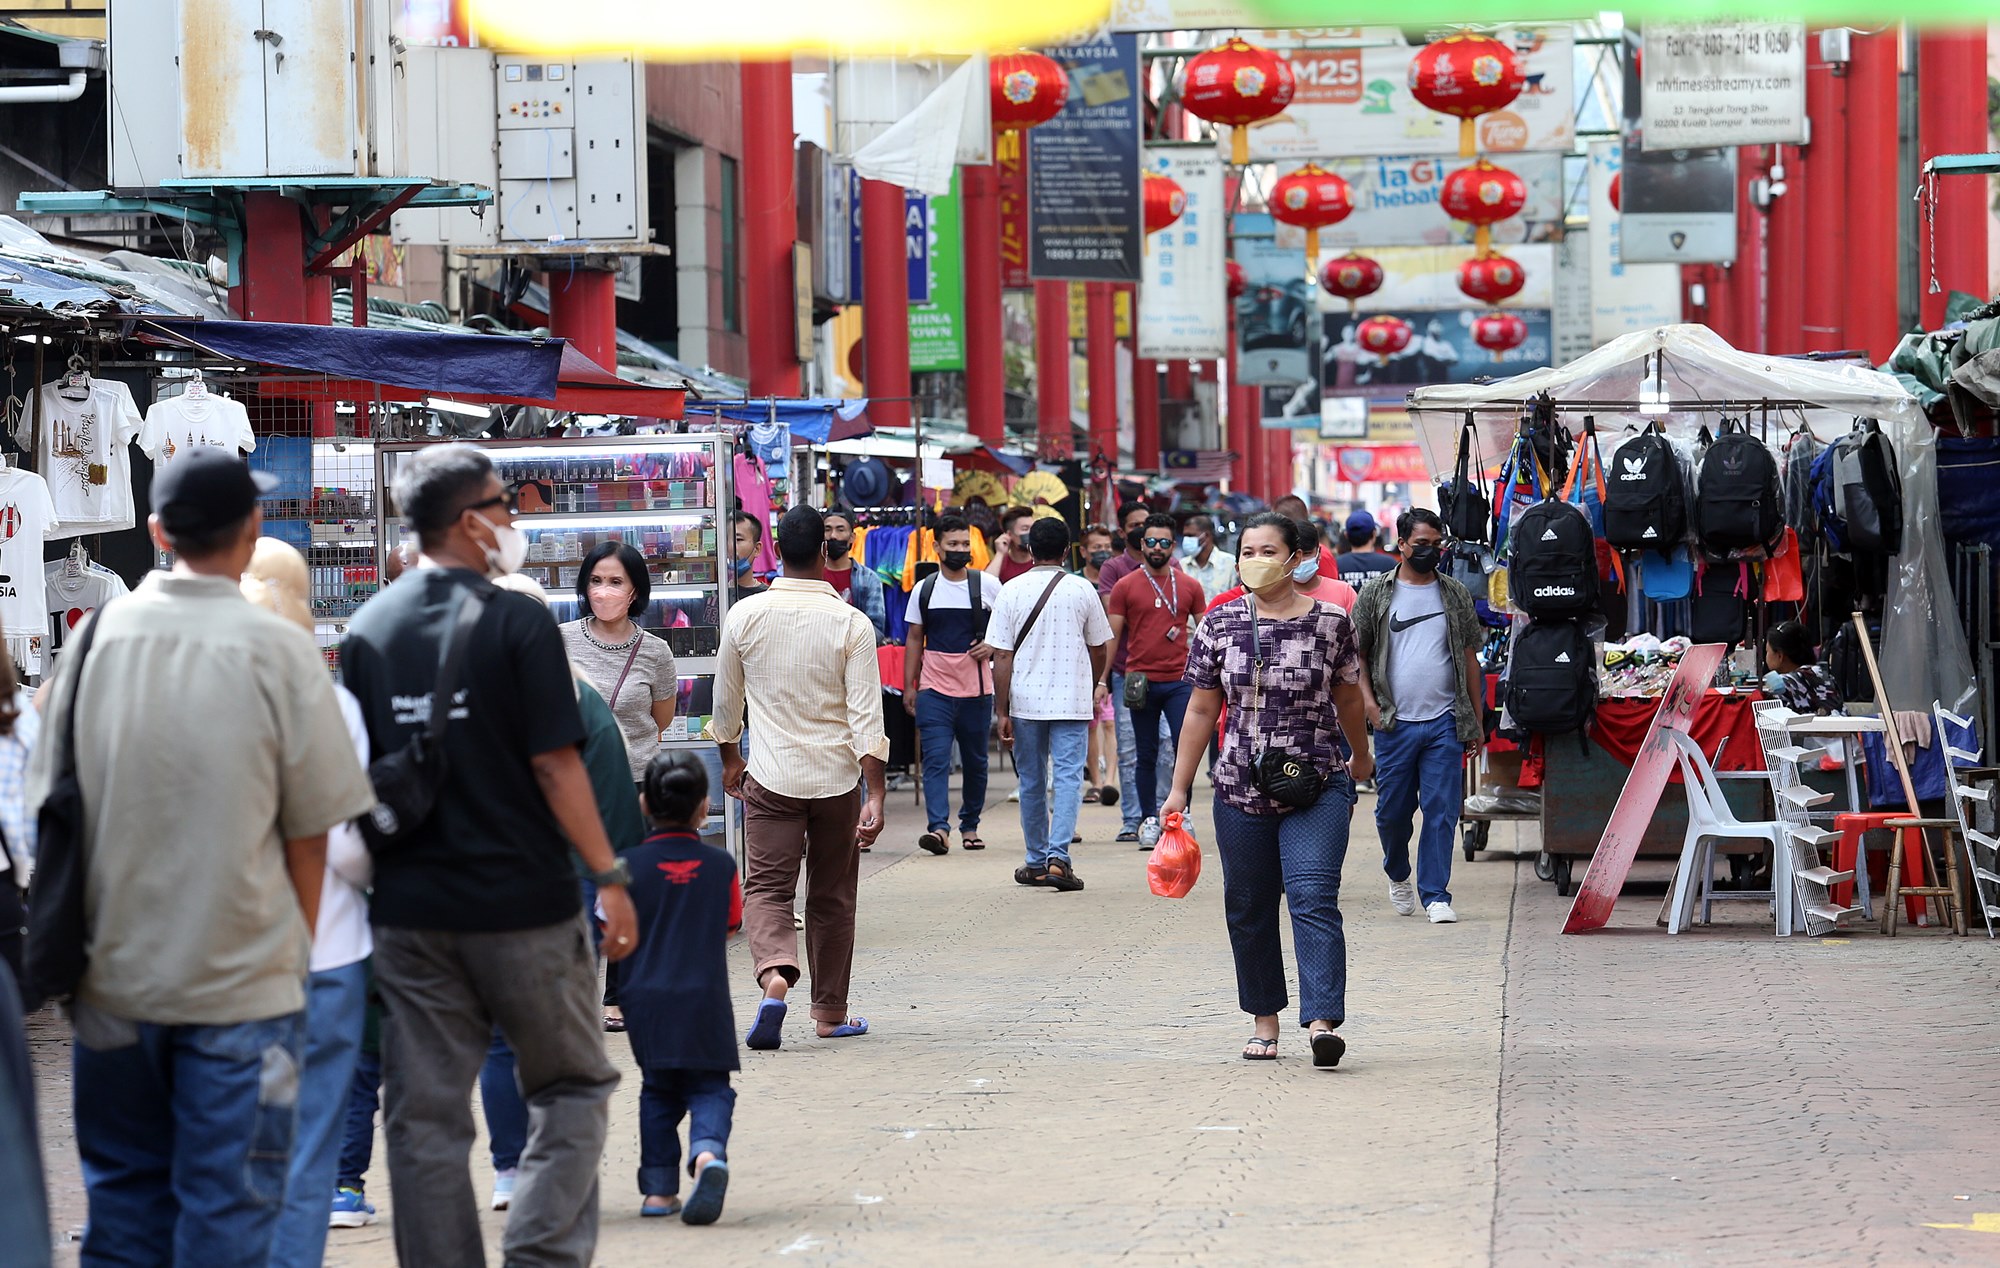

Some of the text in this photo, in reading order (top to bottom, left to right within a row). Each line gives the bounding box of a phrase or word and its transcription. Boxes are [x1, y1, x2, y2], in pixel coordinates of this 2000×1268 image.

[1043, 47, 1119, 58] MALAYSIA
[1291, 59, 1360, 86] M25
[1373, 186, 1440, 210] hebat
[909, 313, 952, 325] HINA
[909, 326, 953, 338] OWN
[1620, 473, 1647, 482] adidas
[1533, 585, 1576, 598] adidas
